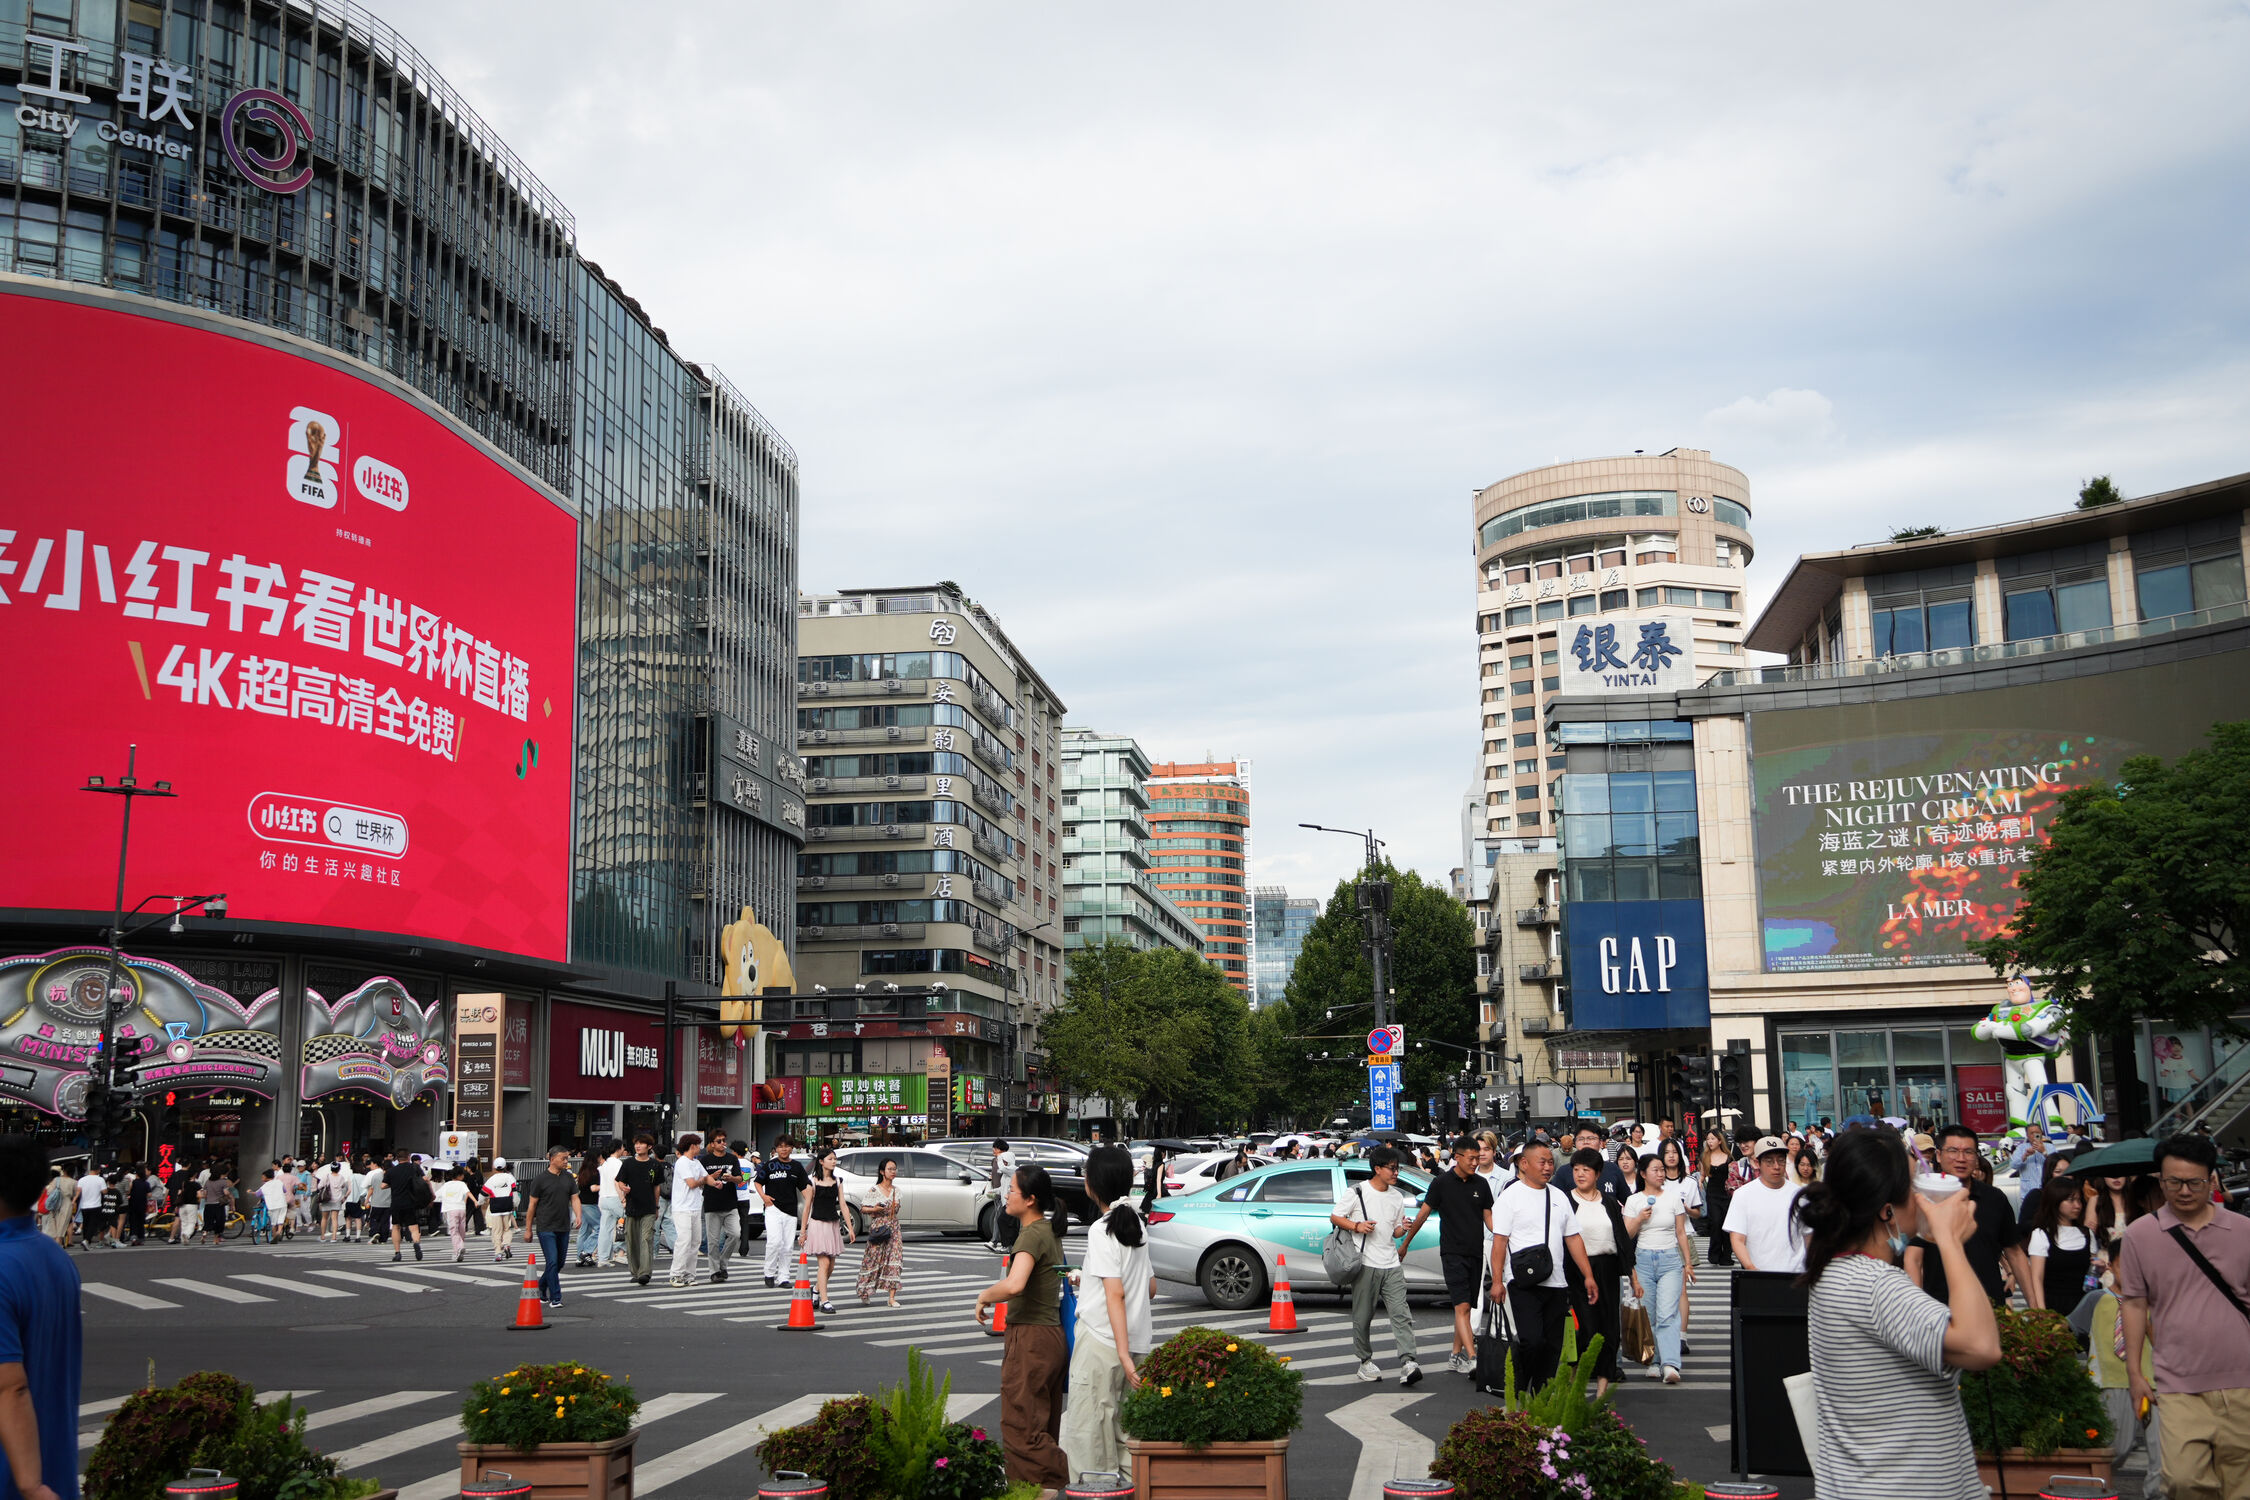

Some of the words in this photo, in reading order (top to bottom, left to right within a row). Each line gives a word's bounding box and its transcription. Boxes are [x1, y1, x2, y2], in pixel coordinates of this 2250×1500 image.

[16, 34, 195, 131] 工联
[15, 105, 80, 139] City
[96, 119, 193, 161] Center
[301, 483, 325, 500] FIFA
[362, 466, 403, 503] 小红书
[0, 528, 530, 723] 小红书看世界杯直播
[1571, 621, 1683, 672] 银泰
[1602, 672, 1657, 687] YINTAI
[156, 643, 456, 763] 4K超高清全免费
[932, 680, 956, 898] 安韵里酒店
[1783, 783, 1842, 806] THE
[1848, 762, 2062, 803] REJUVENATING
[261, 803, 317, 834] 小红书
[356, 819, 395, 846] 世界杯
[1824, 802, 1916, 828] NIGHT
[1921, 792, 2023, 821] CREAM
[260, 851, 401, 887] 你的生活兴趣社区
[1821, 853, 1934, 877] 紧塑内外轮廓
[1887, 903, 1916, 920] LA
[1922, 899, 1975, 918] MER
[1600, 936, 1677, 994] GAP
[926, 996, 939, 1006] 3F
[61, 1028, 116, 1040] 名创优
[581, 1027, 625, 1078] MUJI
[626, 1044, 658, 1069] 無印良品
[841, 1079, 901, 1093] 现炒快餐
[841, 1093, 900, 1105] 爆炒浇头面
[1965, 1091, 2004, 1103] SALE
[1373, 1086, 1387, 1125] 平海路
